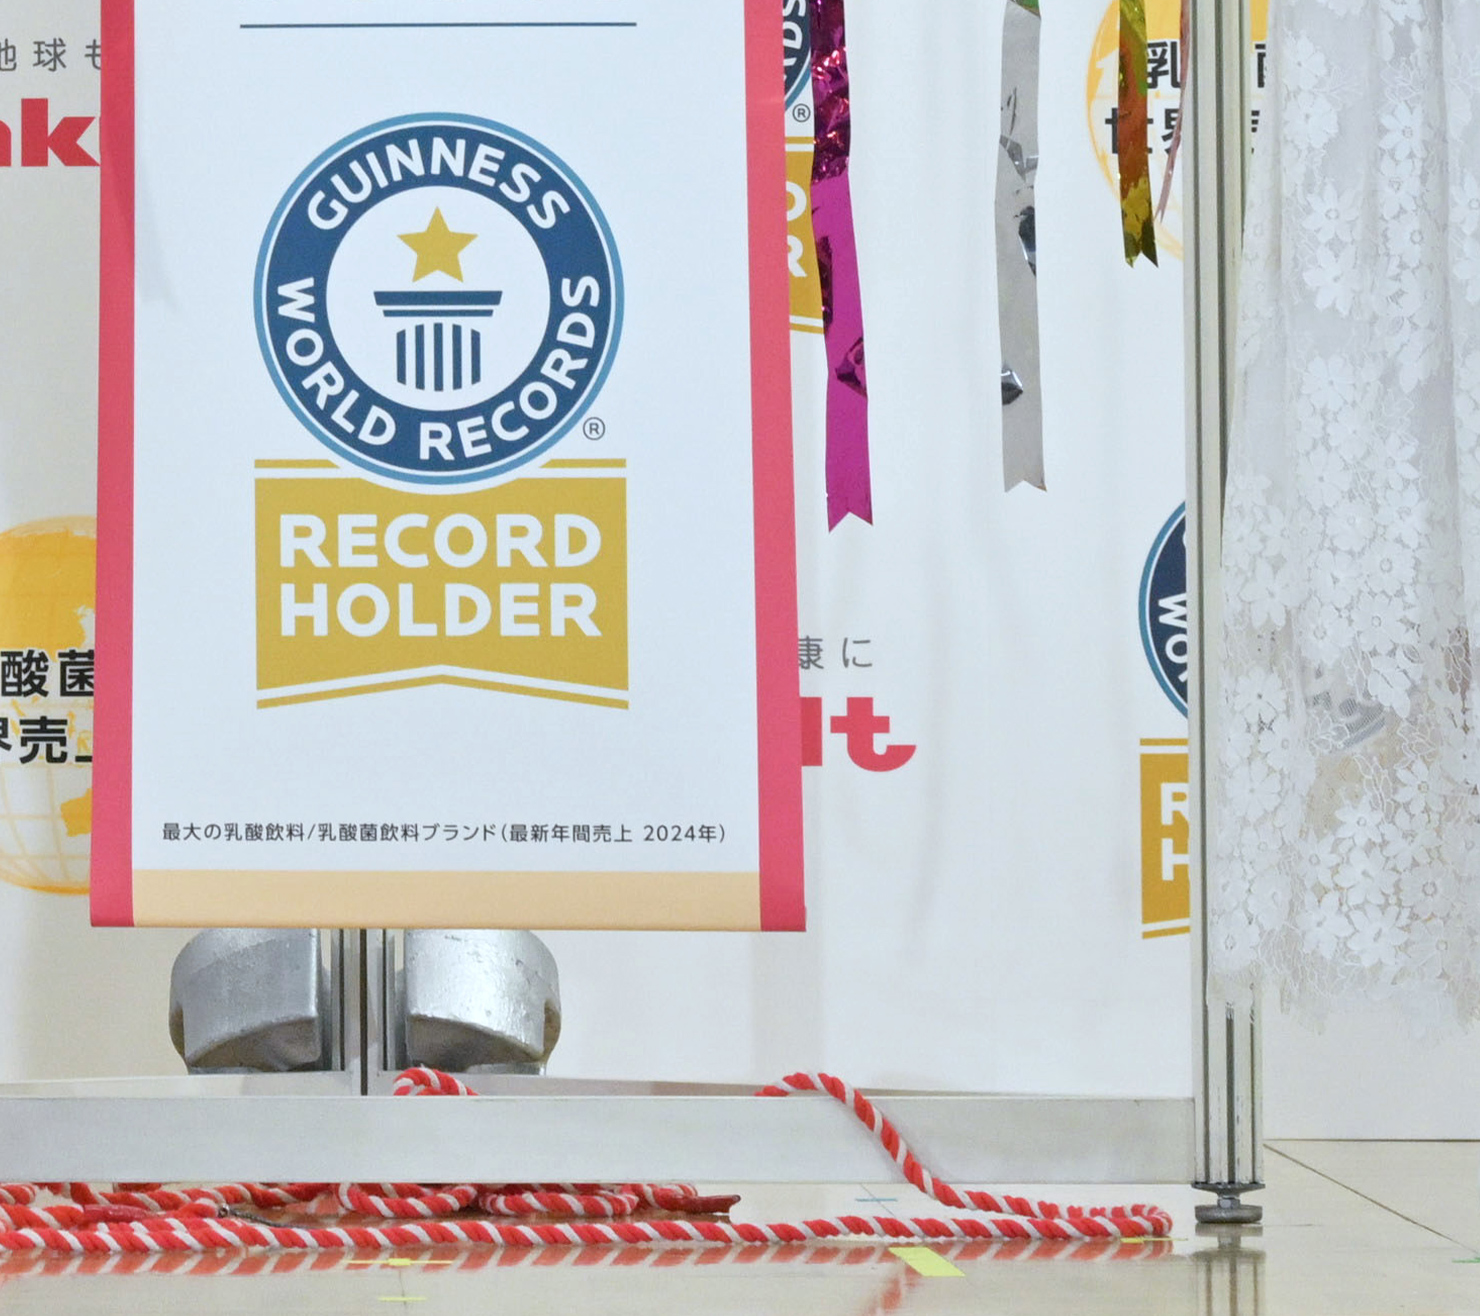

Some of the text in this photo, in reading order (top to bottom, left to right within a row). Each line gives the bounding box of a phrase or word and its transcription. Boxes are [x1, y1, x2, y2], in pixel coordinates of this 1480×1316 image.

[307, 137, 571, 232] GUINNESS
[277, 275, 600, 461] WORLD RECORDS
[279, 513, 601, 568] RECORD
[280, 582, 602, 637] HOLDER
